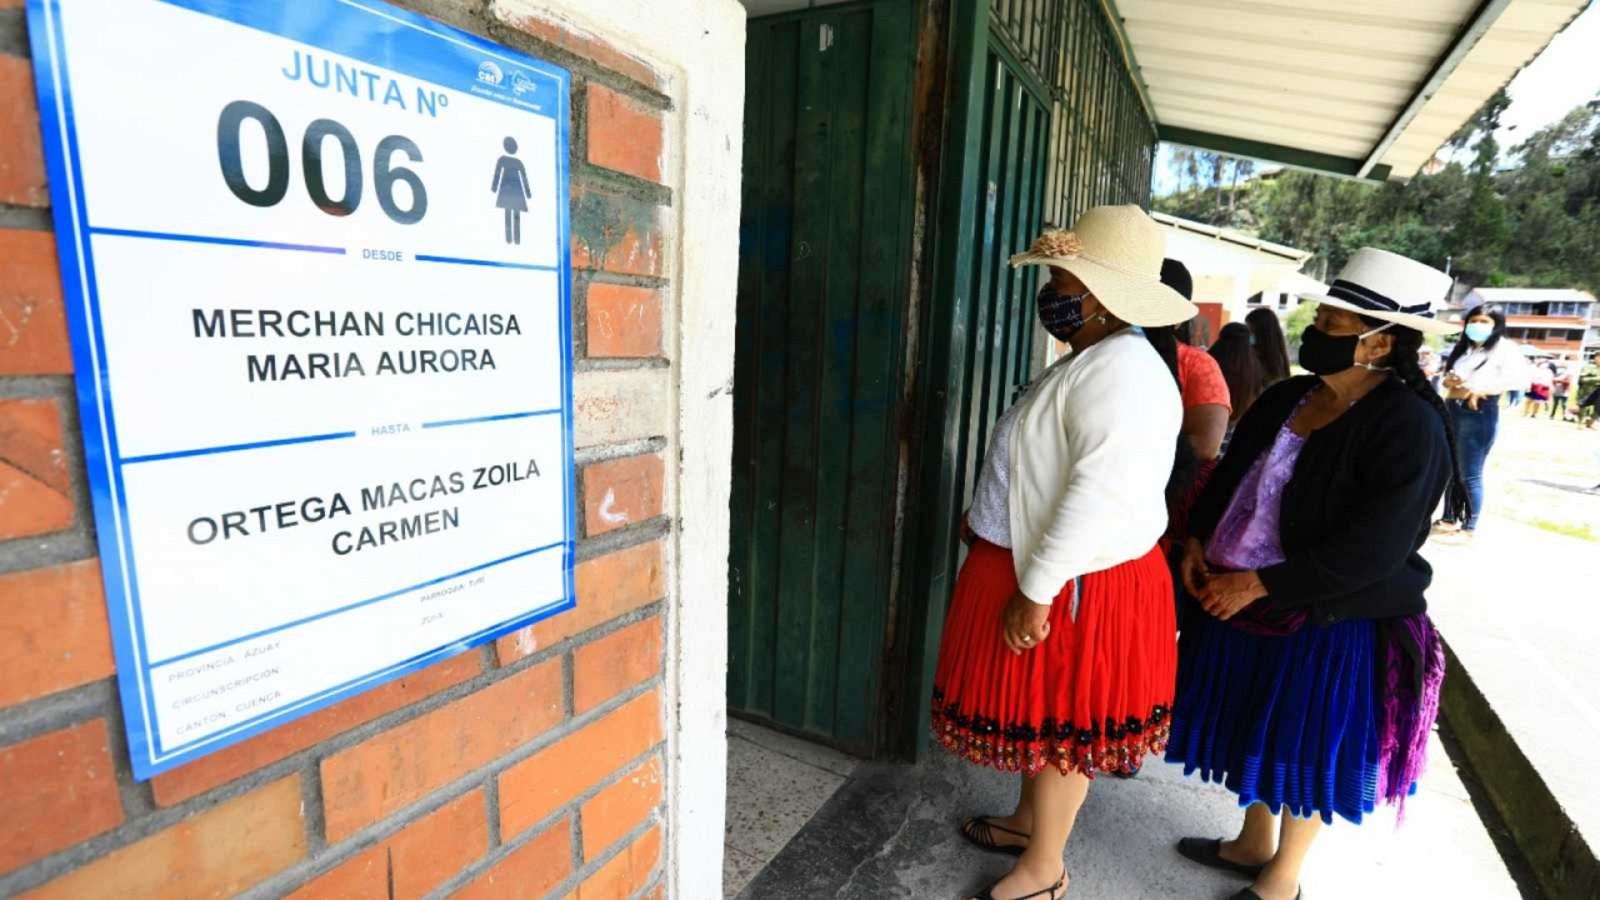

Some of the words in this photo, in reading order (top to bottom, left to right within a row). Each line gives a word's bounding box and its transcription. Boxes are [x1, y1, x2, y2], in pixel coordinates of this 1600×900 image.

[281, 51, 407, 110] JUNTA
[216, 100, 428, 225] 006
[362, 248, 404, 262] DESDE
[192, 308, 384, 338] MERCHAN
[395, 311, 522, 336] CHICAISA
[246, 352, 366, 383] MARIA
[376, 349, 496, 375] AURORA
[370, 423, 411, 436] HASTA
[187, 492, 352, 545] ORTEGA
[361, 471, 465, 513] MACAS
[472, 459, 541, 490] ZOILA
[332, 506, 460, 556] CARMEN
